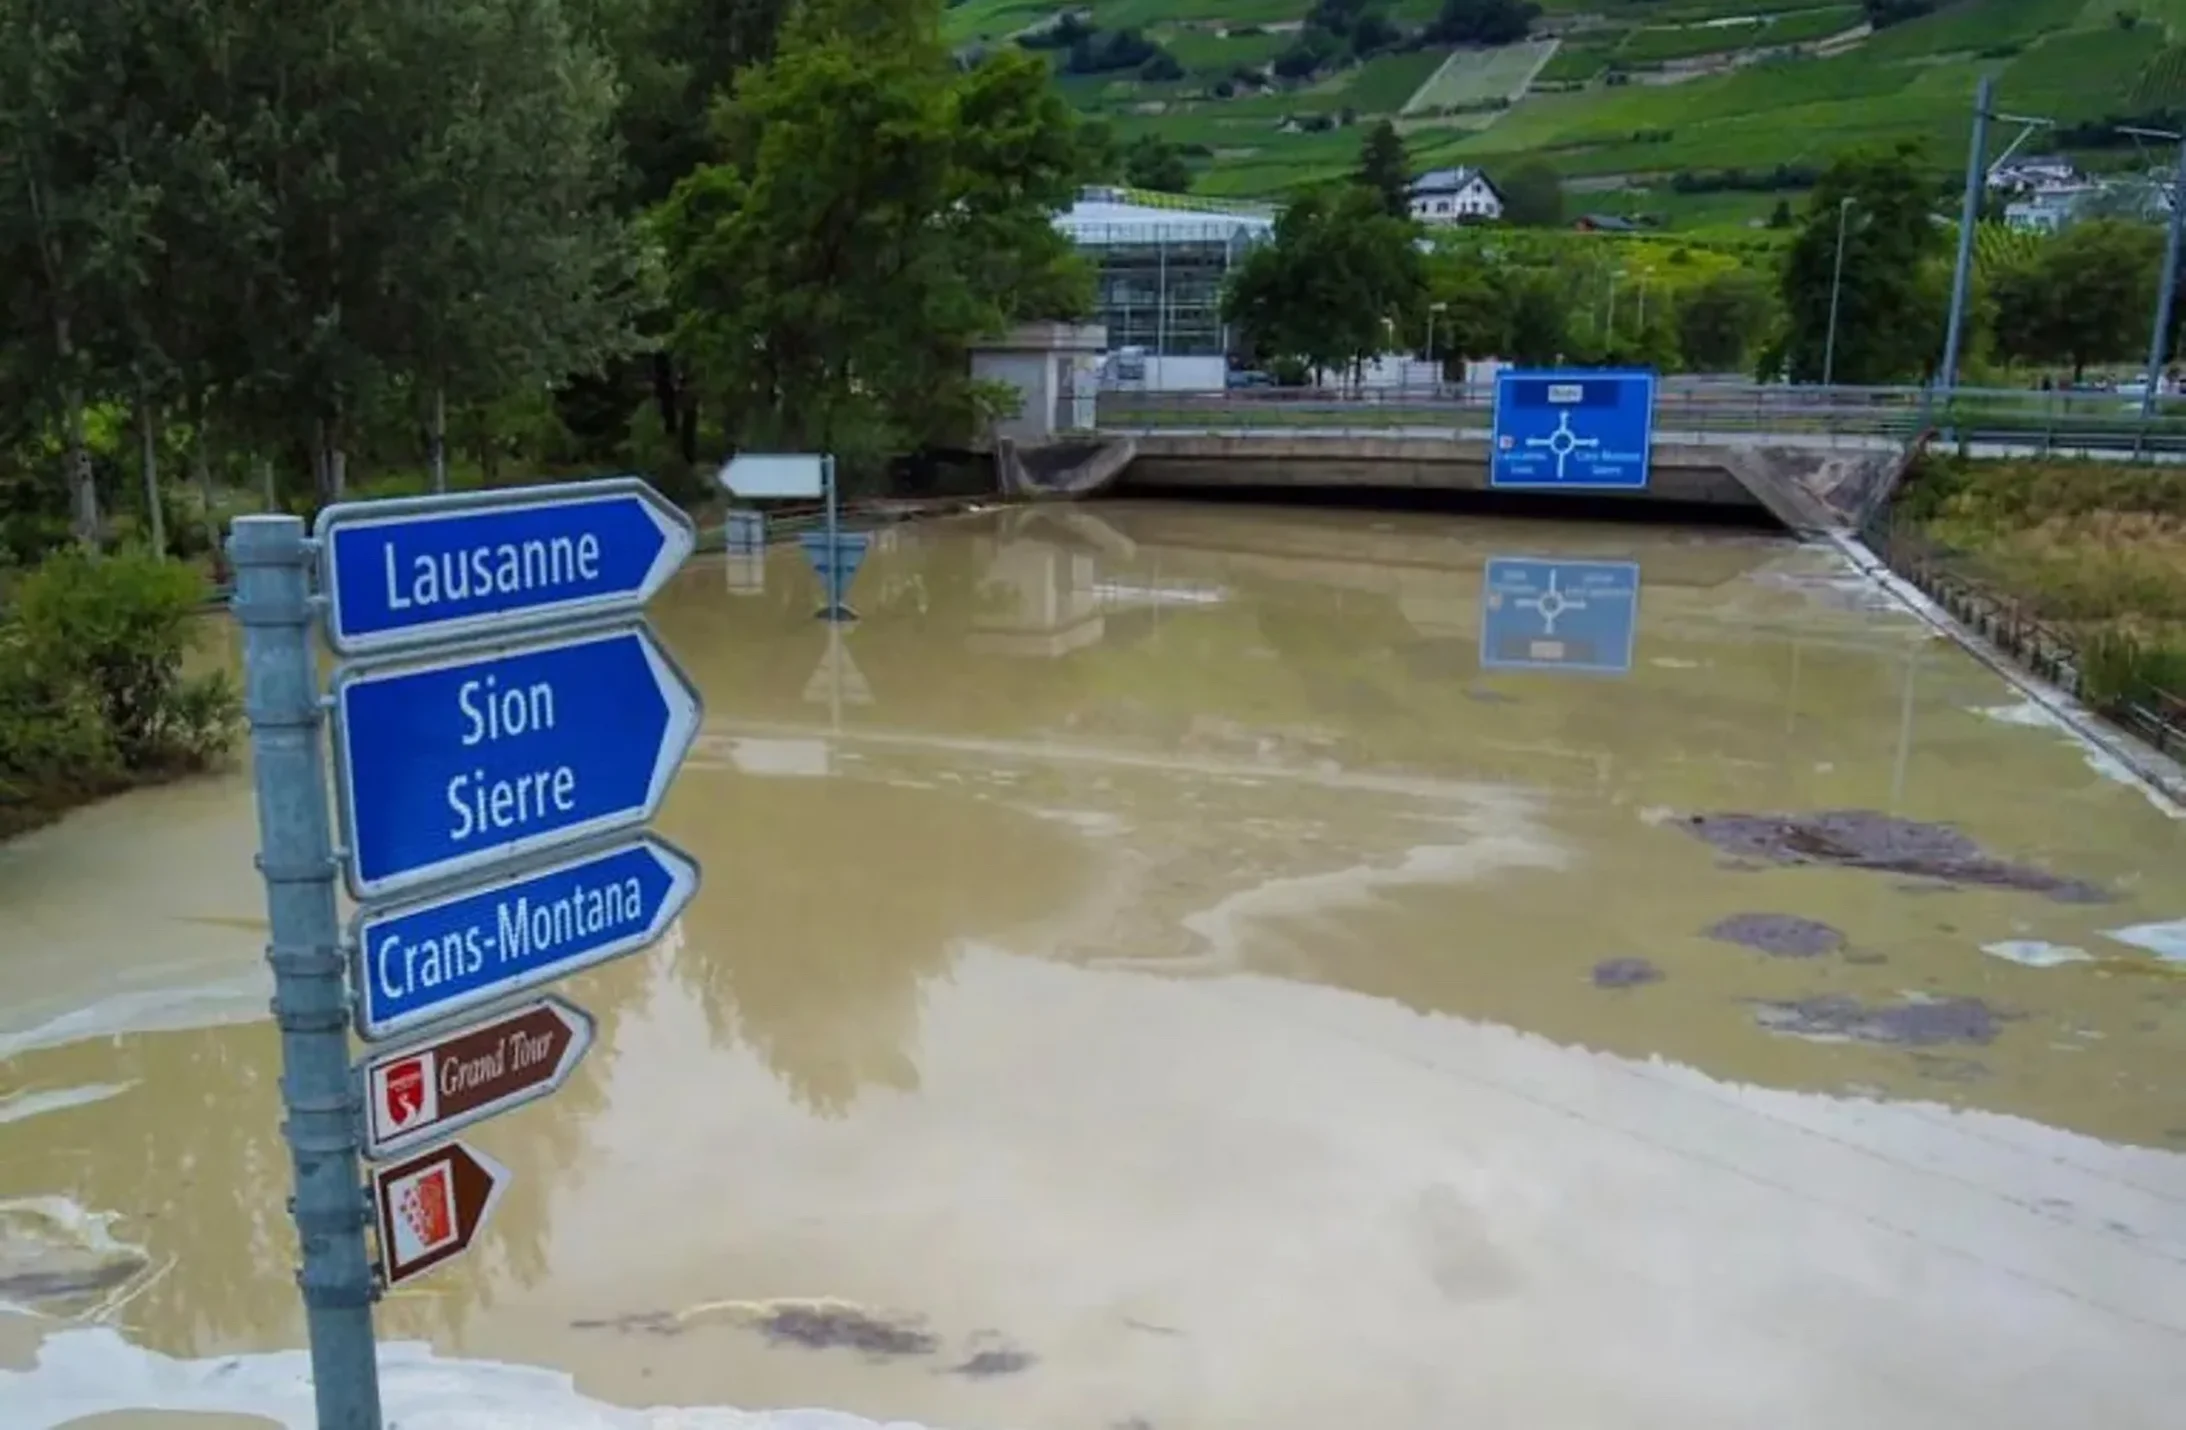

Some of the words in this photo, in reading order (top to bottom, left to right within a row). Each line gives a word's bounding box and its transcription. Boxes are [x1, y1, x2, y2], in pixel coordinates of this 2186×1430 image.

[385, 532, 599, 610] Lausanne
[459, 675, 554, 745] Sion
[447, 765, 575, 839] Sierre
[379, 877, 642, 998] Crans-Montana
[441, 1037, 505, 1096] Grand
[510, 1030, 553, 1071] Tour
